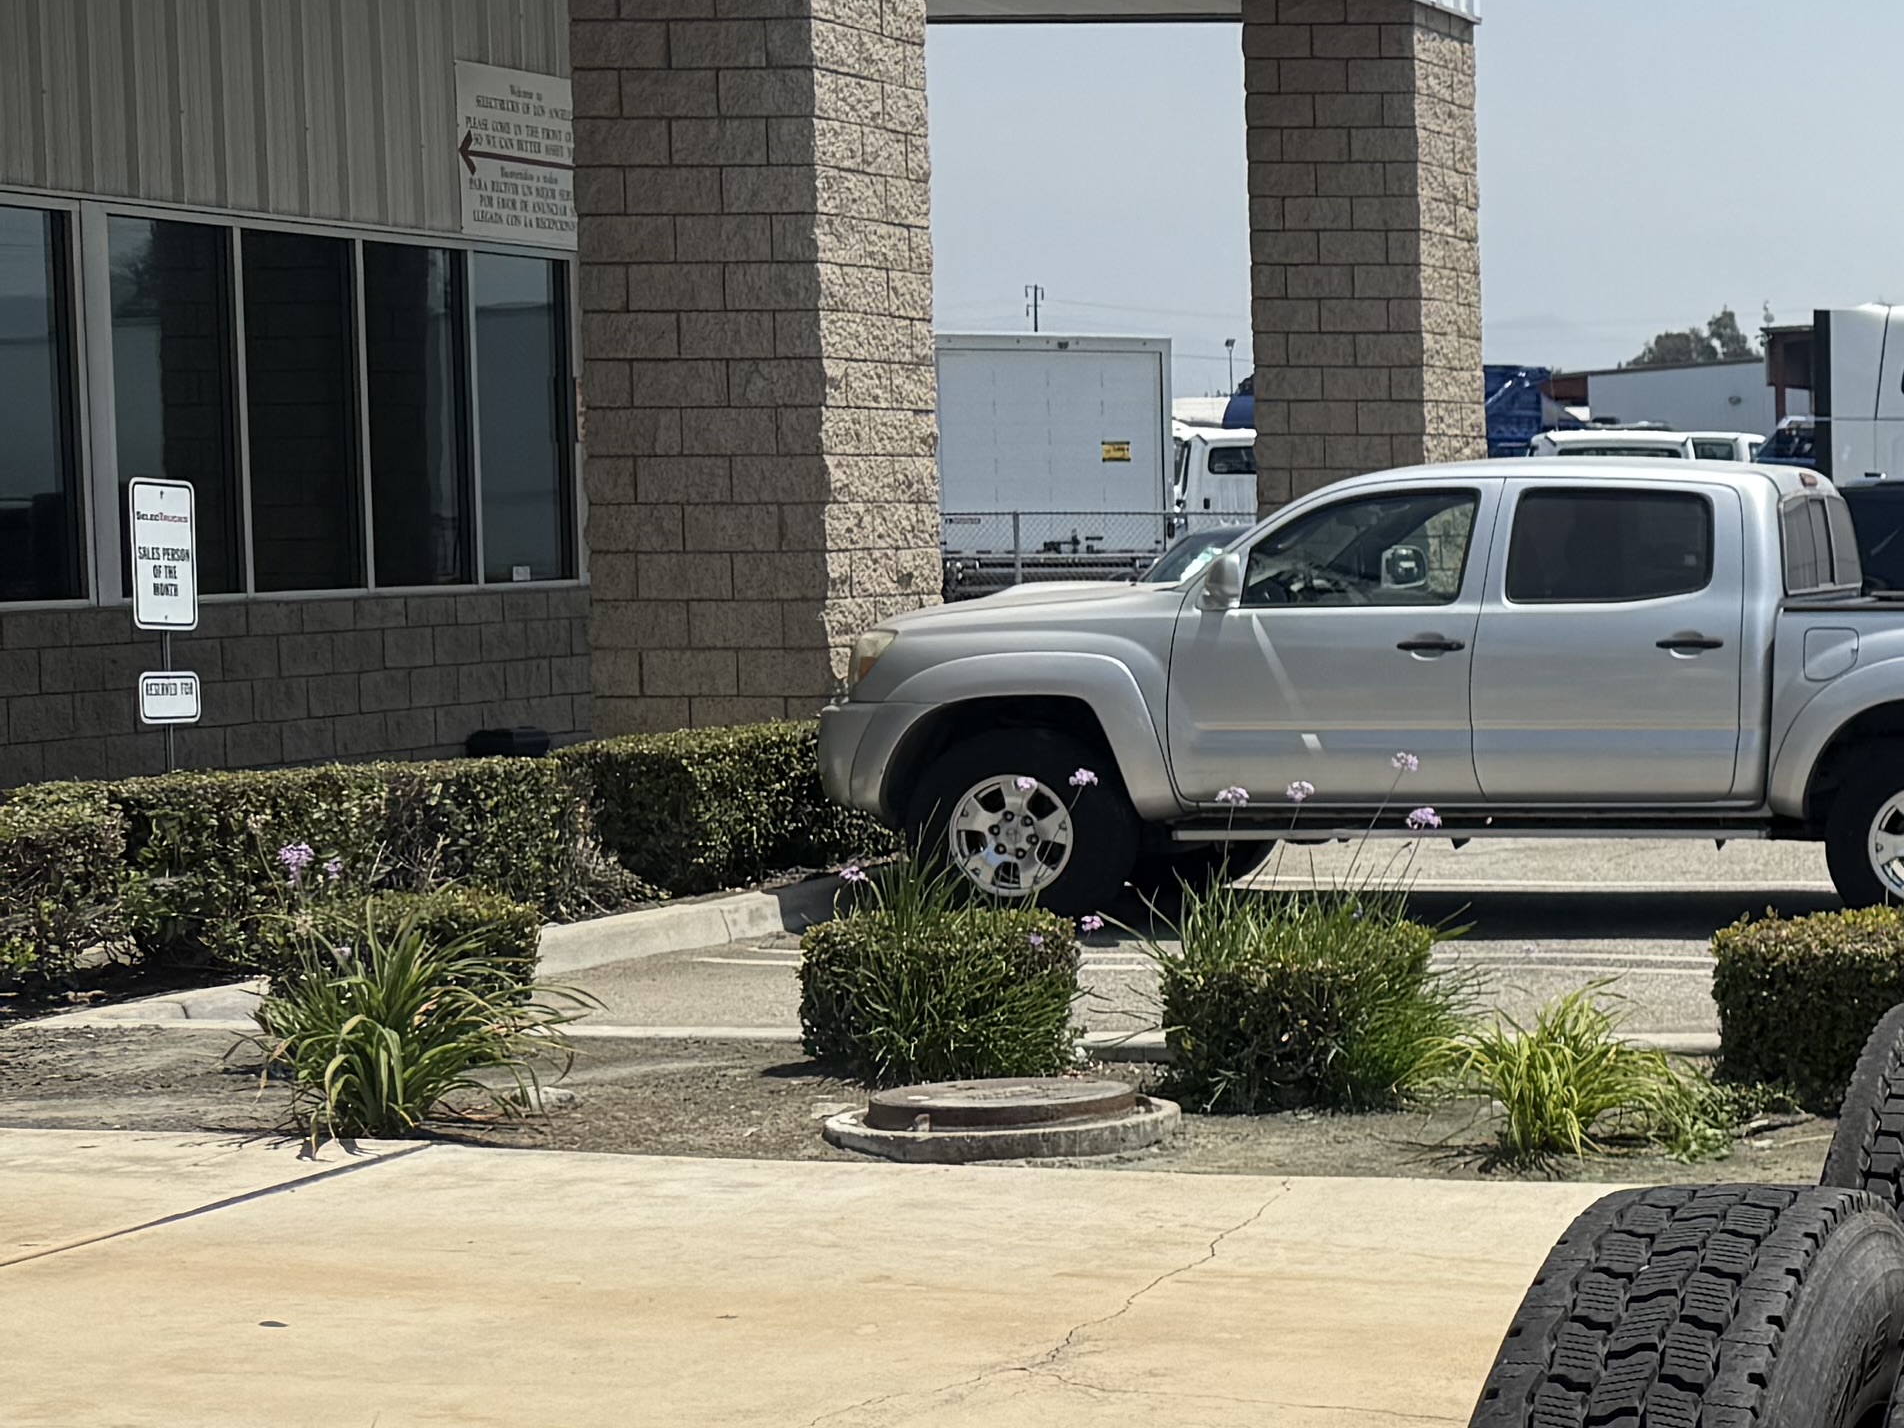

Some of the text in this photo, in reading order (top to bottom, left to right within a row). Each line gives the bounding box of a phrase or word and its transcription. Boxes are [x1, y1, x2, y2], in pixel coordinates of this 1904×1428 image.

[137, 546, 190, 562] SALES PERSON
[152, 565, 178, 580] OF THE
[152, 582, 179, 597] MONTH
